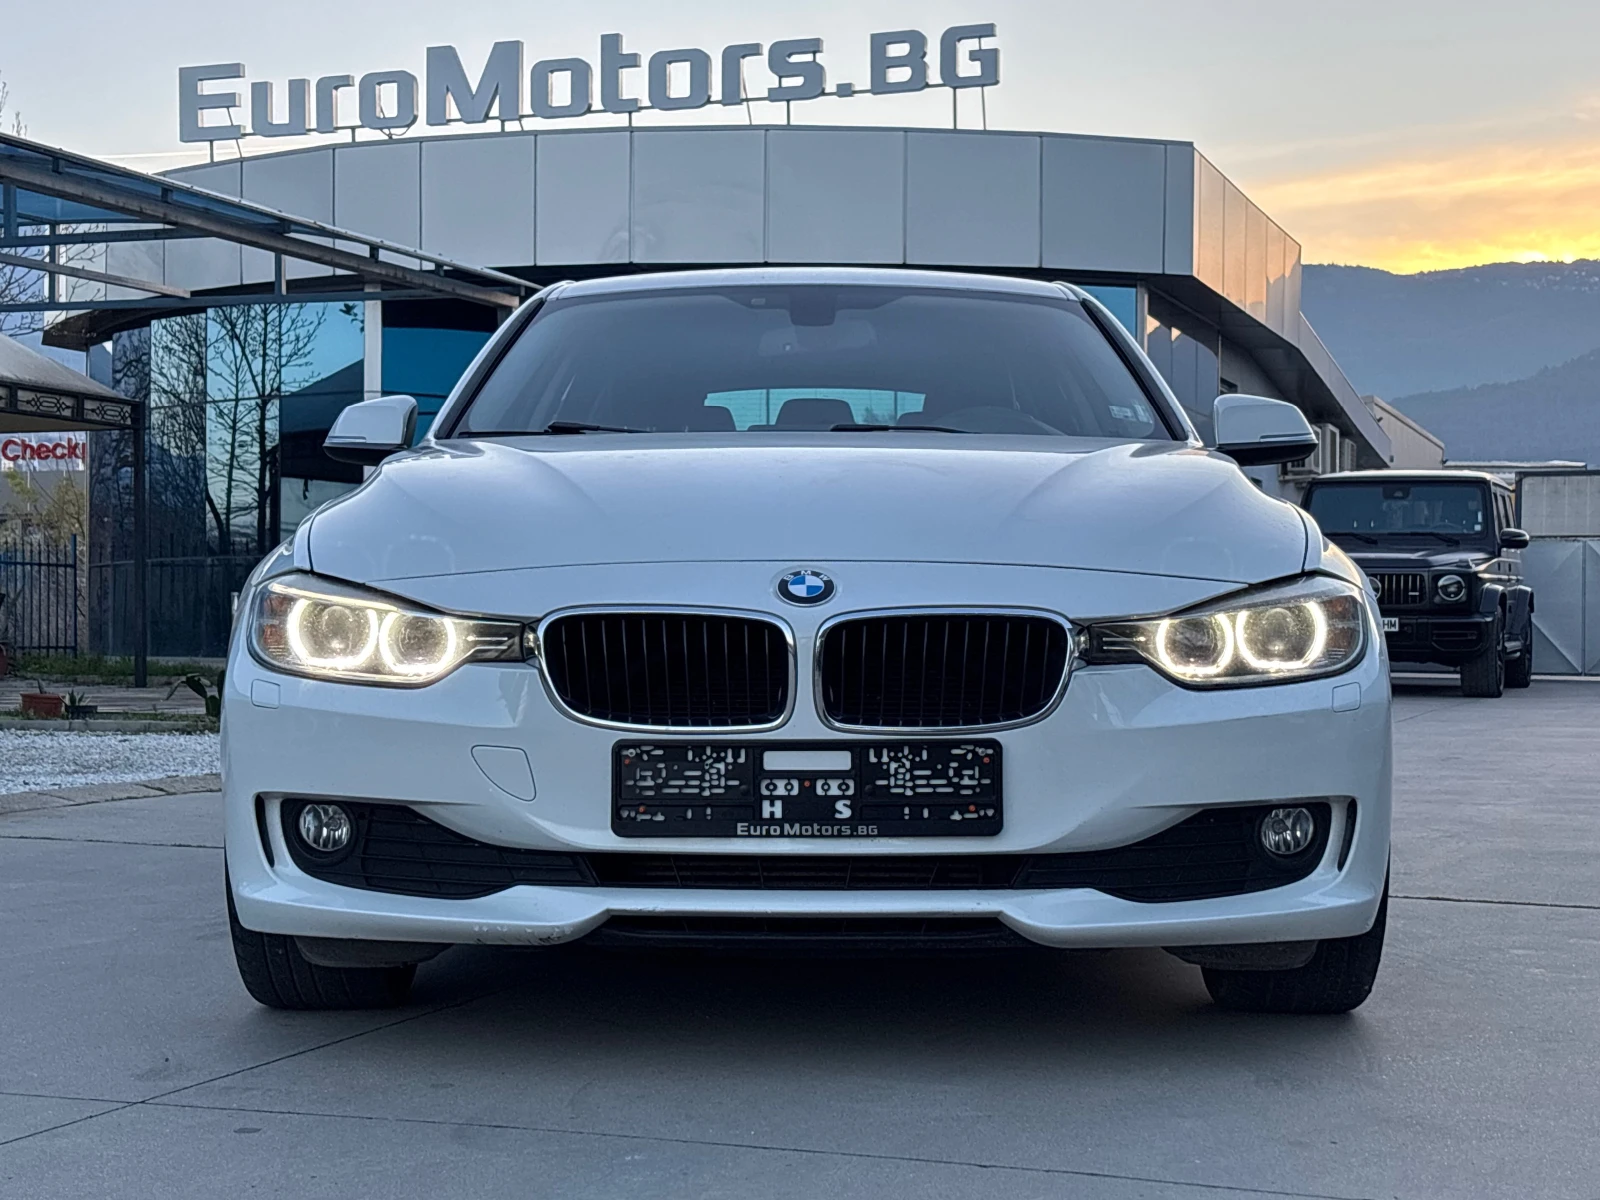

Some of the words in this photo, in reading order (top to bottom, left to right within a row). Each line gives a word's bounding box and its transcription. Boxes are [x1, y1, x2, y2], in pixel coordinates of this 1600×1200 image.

[179, 23, 1001, 143] EuroMotors.BG
[783, 570, 831, 580] BMW
[736, 822, 878, 836] EuroMotors.BG
